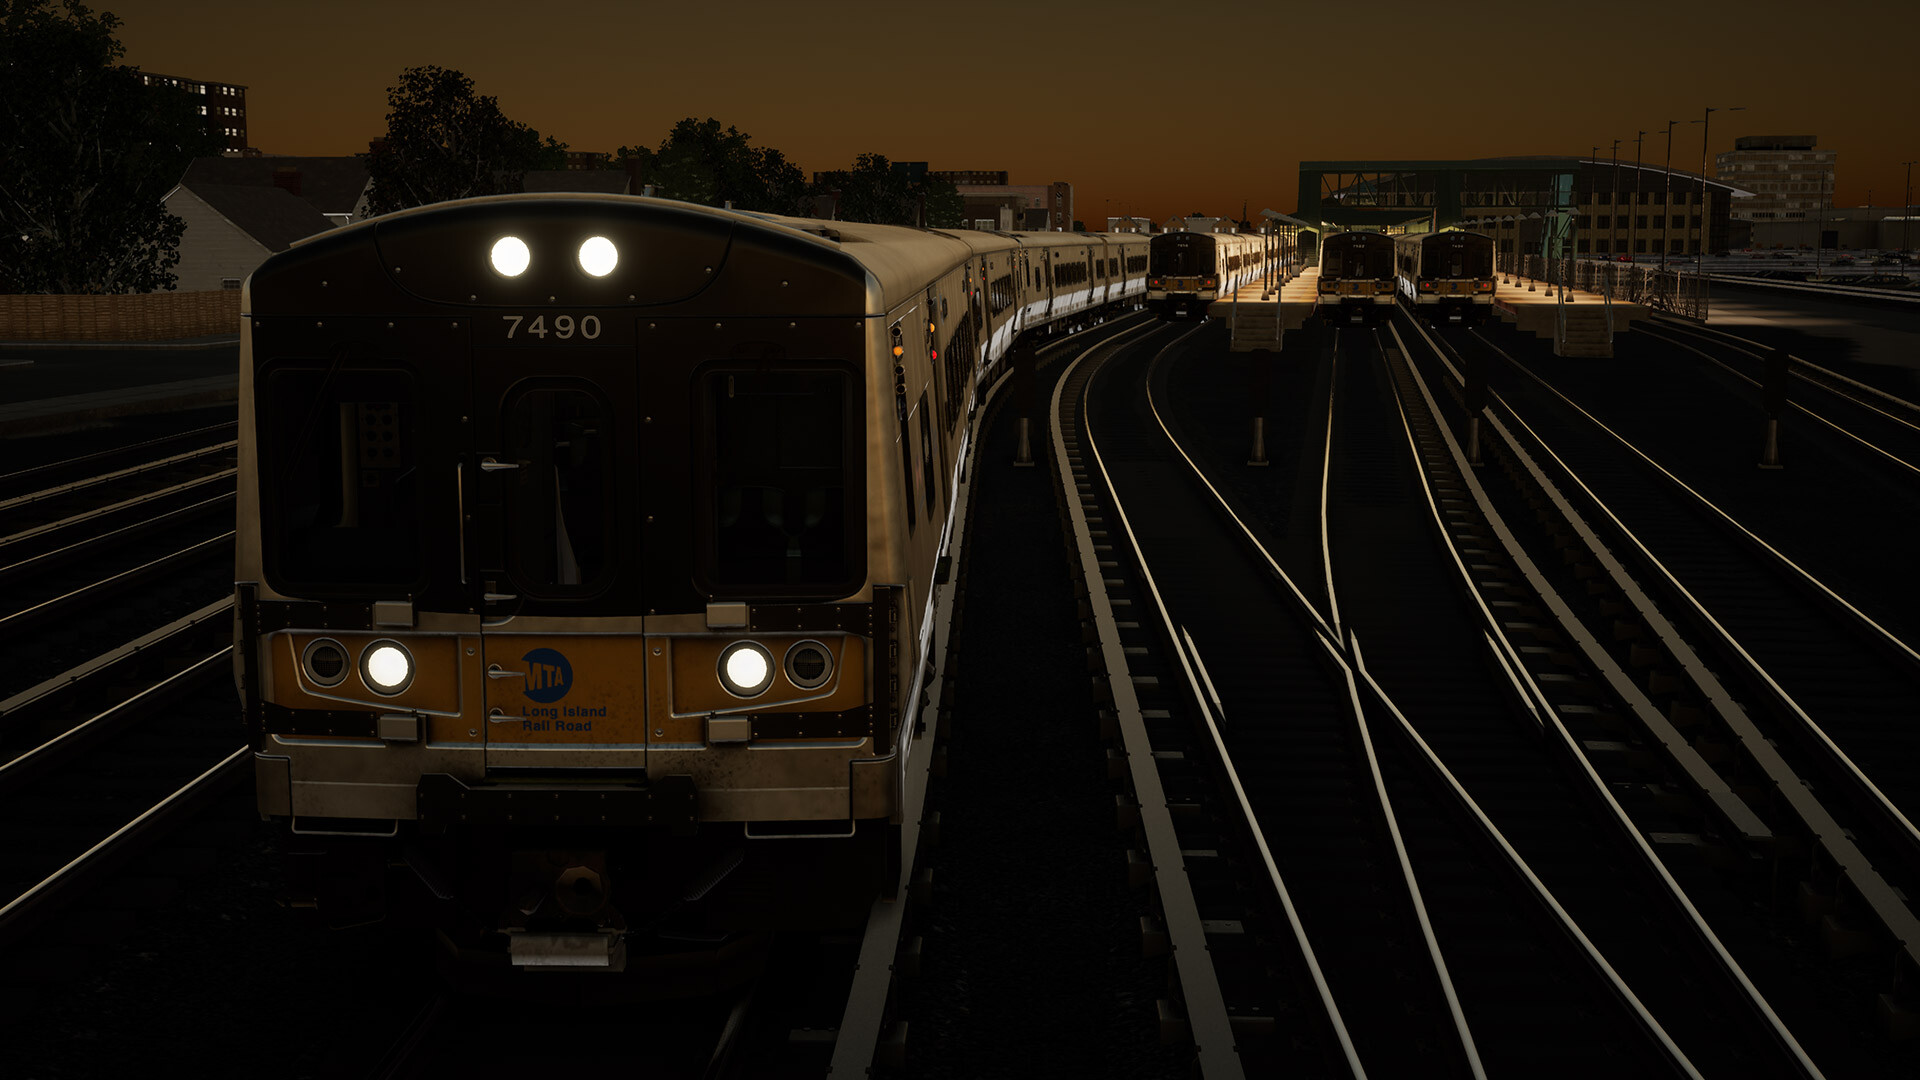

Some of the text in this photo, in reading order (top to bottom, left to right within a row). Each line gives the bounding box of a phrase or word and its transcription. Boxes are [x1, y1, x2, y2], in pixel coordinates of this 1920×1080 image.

[502, 314, 602, 340] 7490
[522, 660, 565, 692] MTA
[522, 706, 607, 720] Long Island
[522, 720, 592, 732] Rail Road
